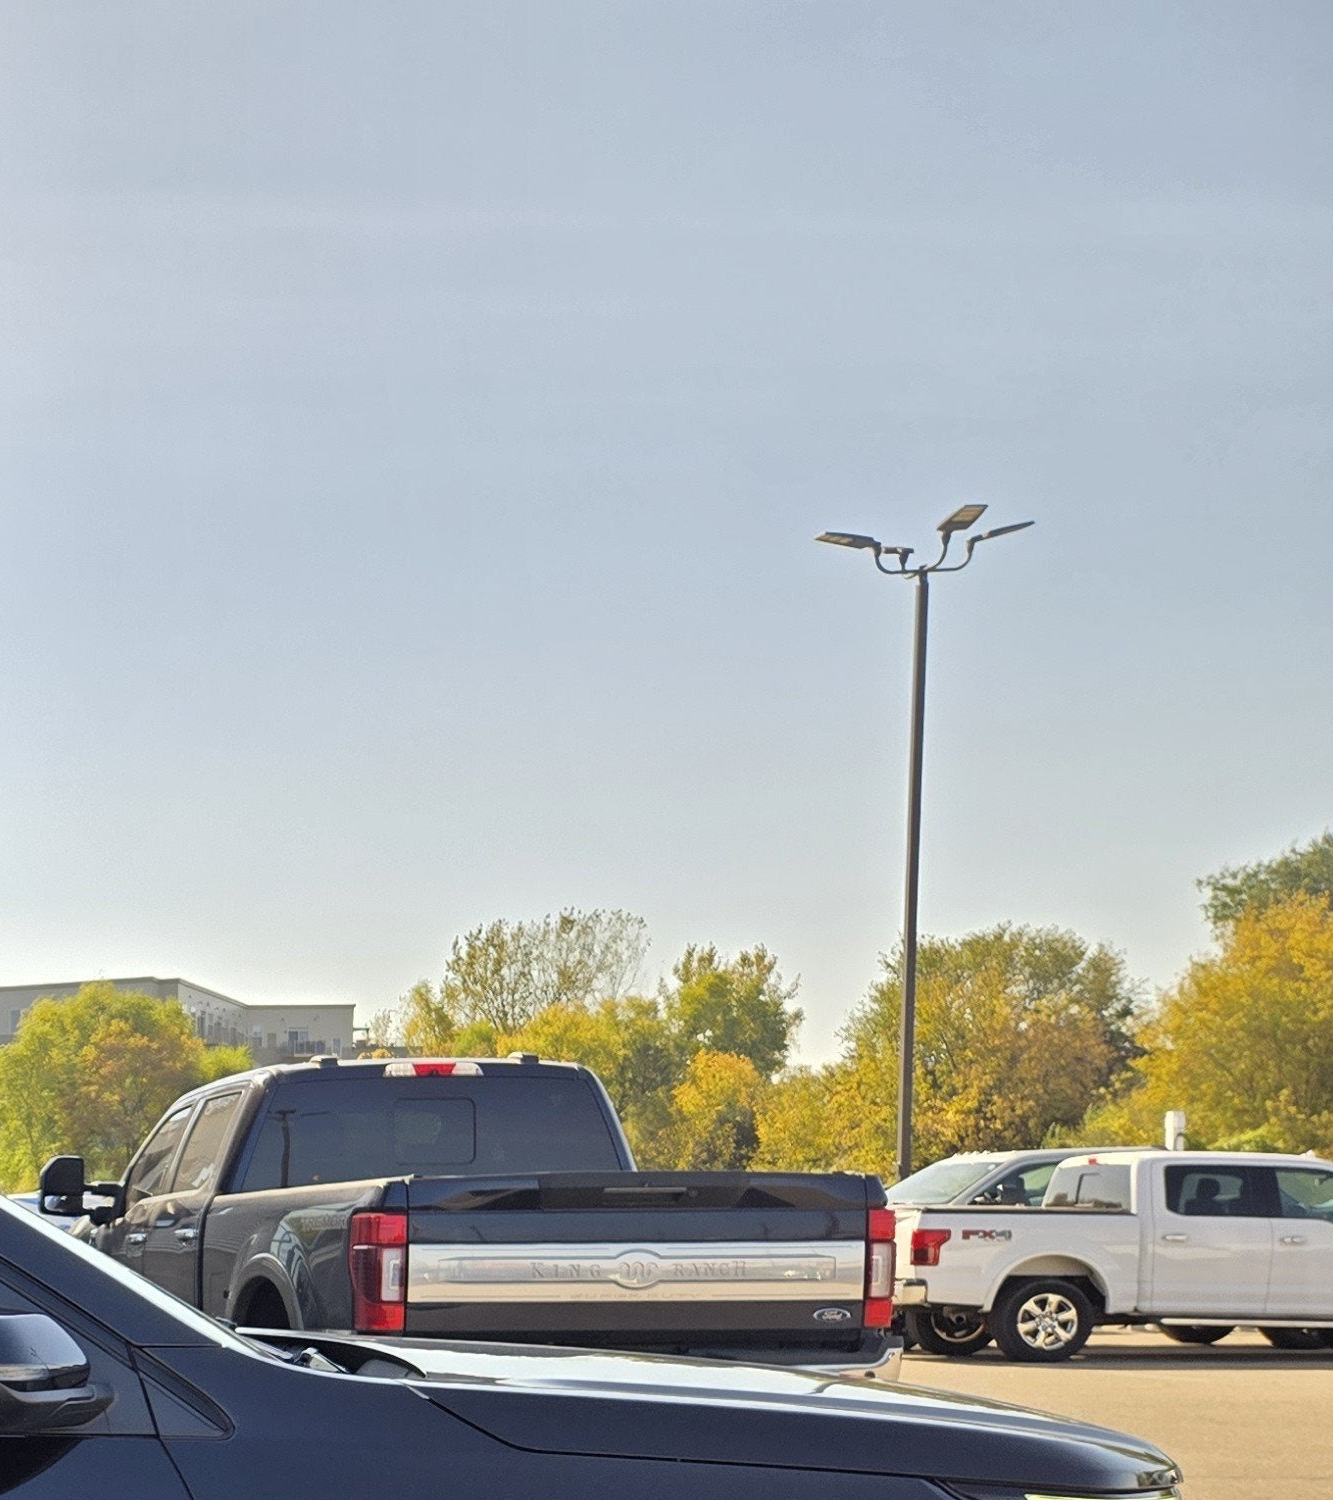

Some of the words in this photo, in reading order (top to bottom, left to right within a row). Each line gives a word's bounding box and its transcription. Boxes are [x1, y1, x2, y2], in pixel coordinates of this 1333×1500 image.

[961, 1229, 1012, 1241] FX4
[529, 1261, 602, 1280] KING
[672, 1259, 747, 1279] RANCH
